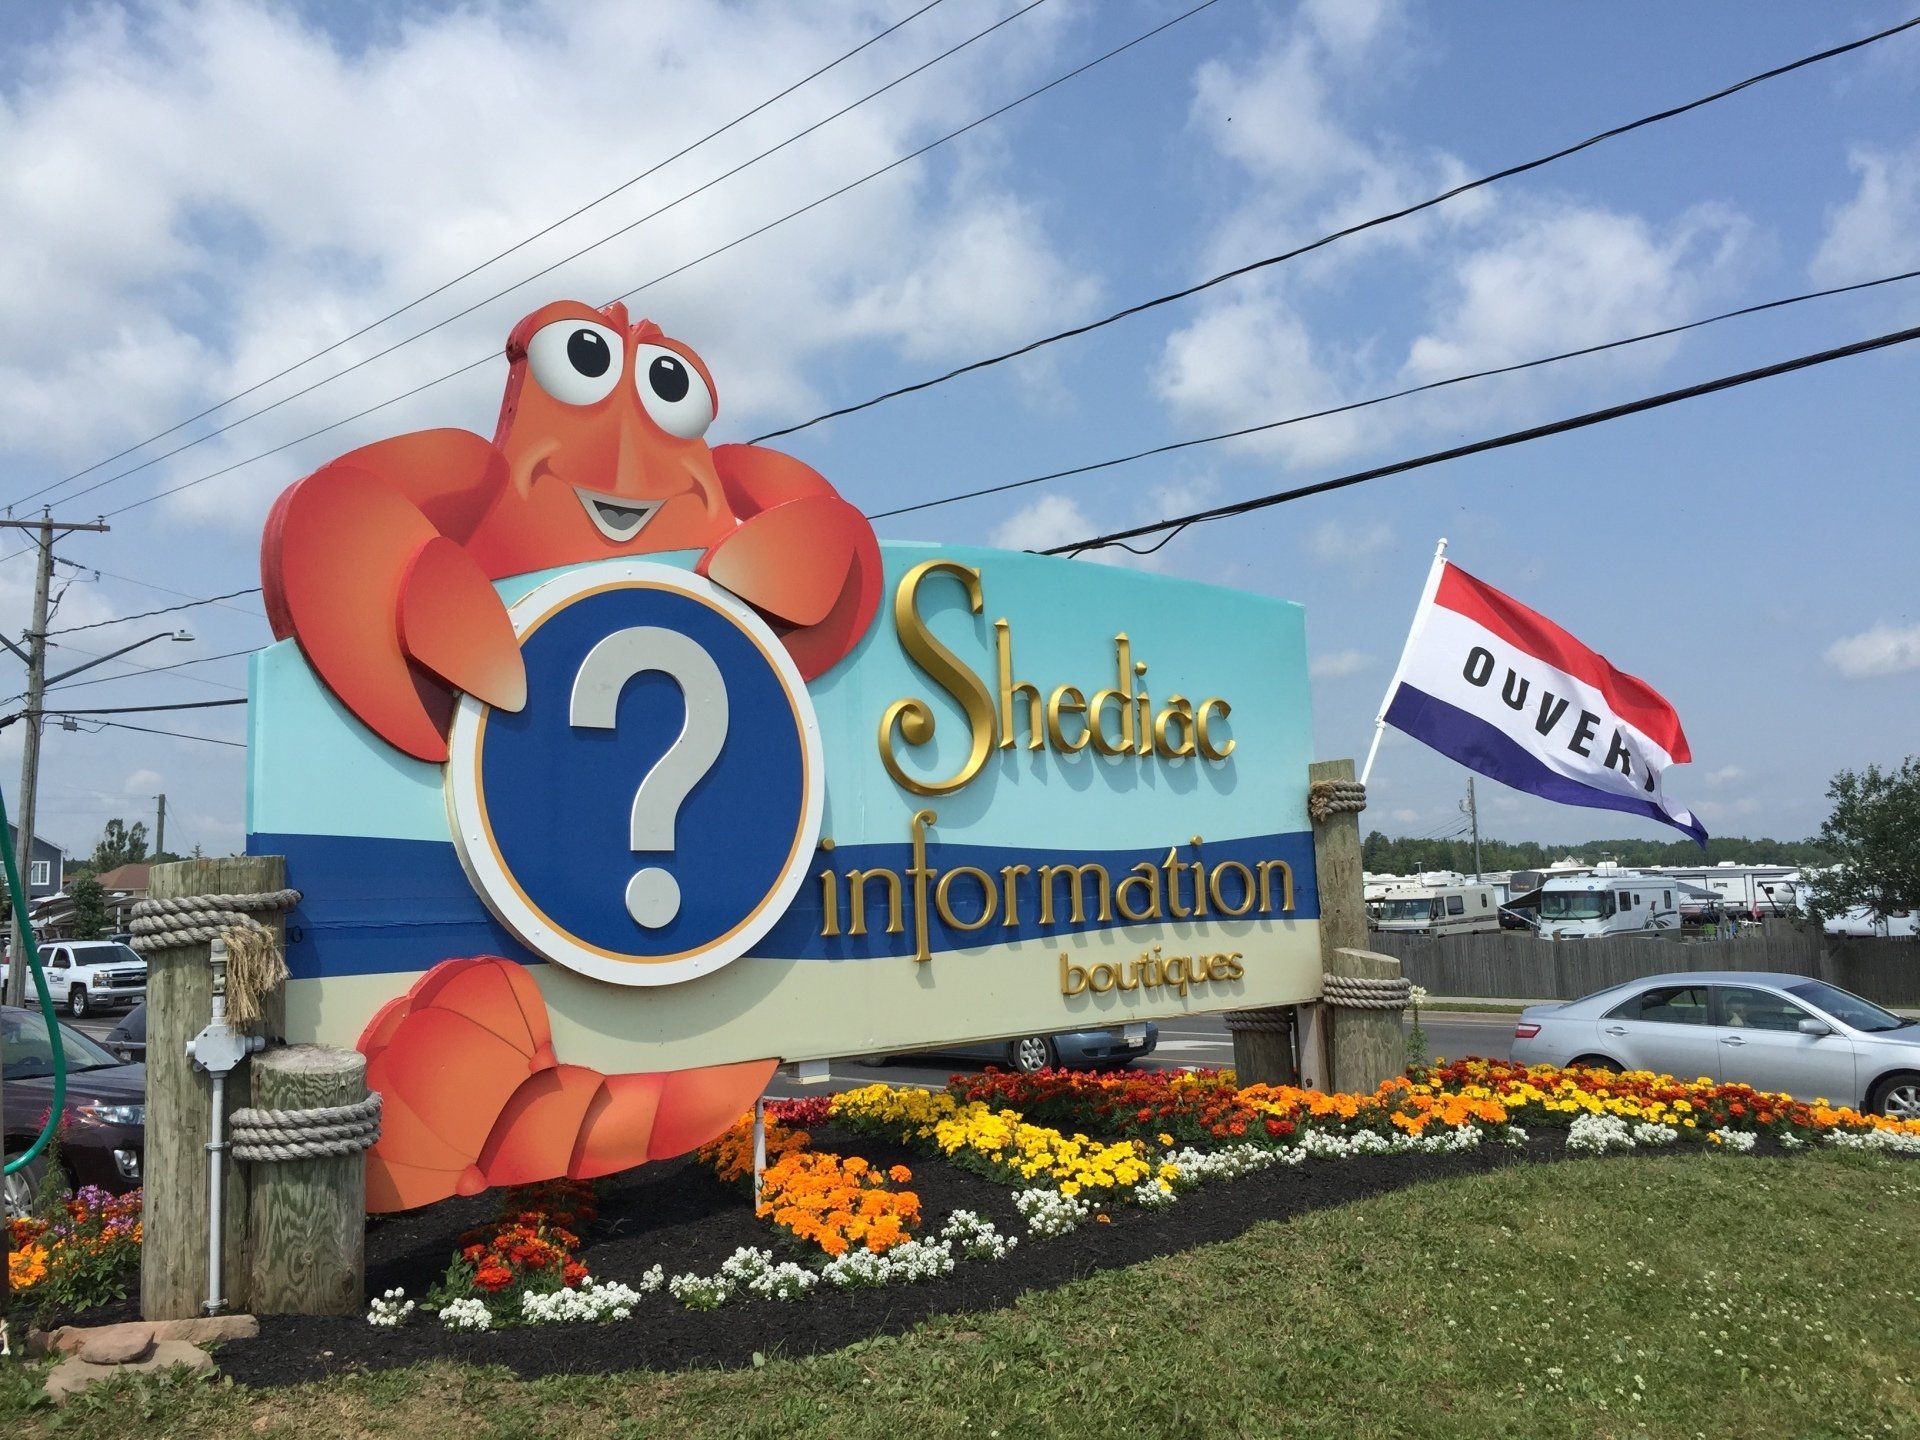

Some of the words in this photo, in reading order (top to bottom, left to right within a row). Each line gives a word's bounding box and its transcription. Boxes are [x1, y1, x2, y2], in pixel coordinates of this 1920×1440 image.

[879, 560, 1236, 795] Shediac
[1462, 646, 1655, 793] OUVER
[569, 626, 729, 928] ?
[820, 809, 1295, 962] information
[1059, 945, 1245, 997] boutiques
